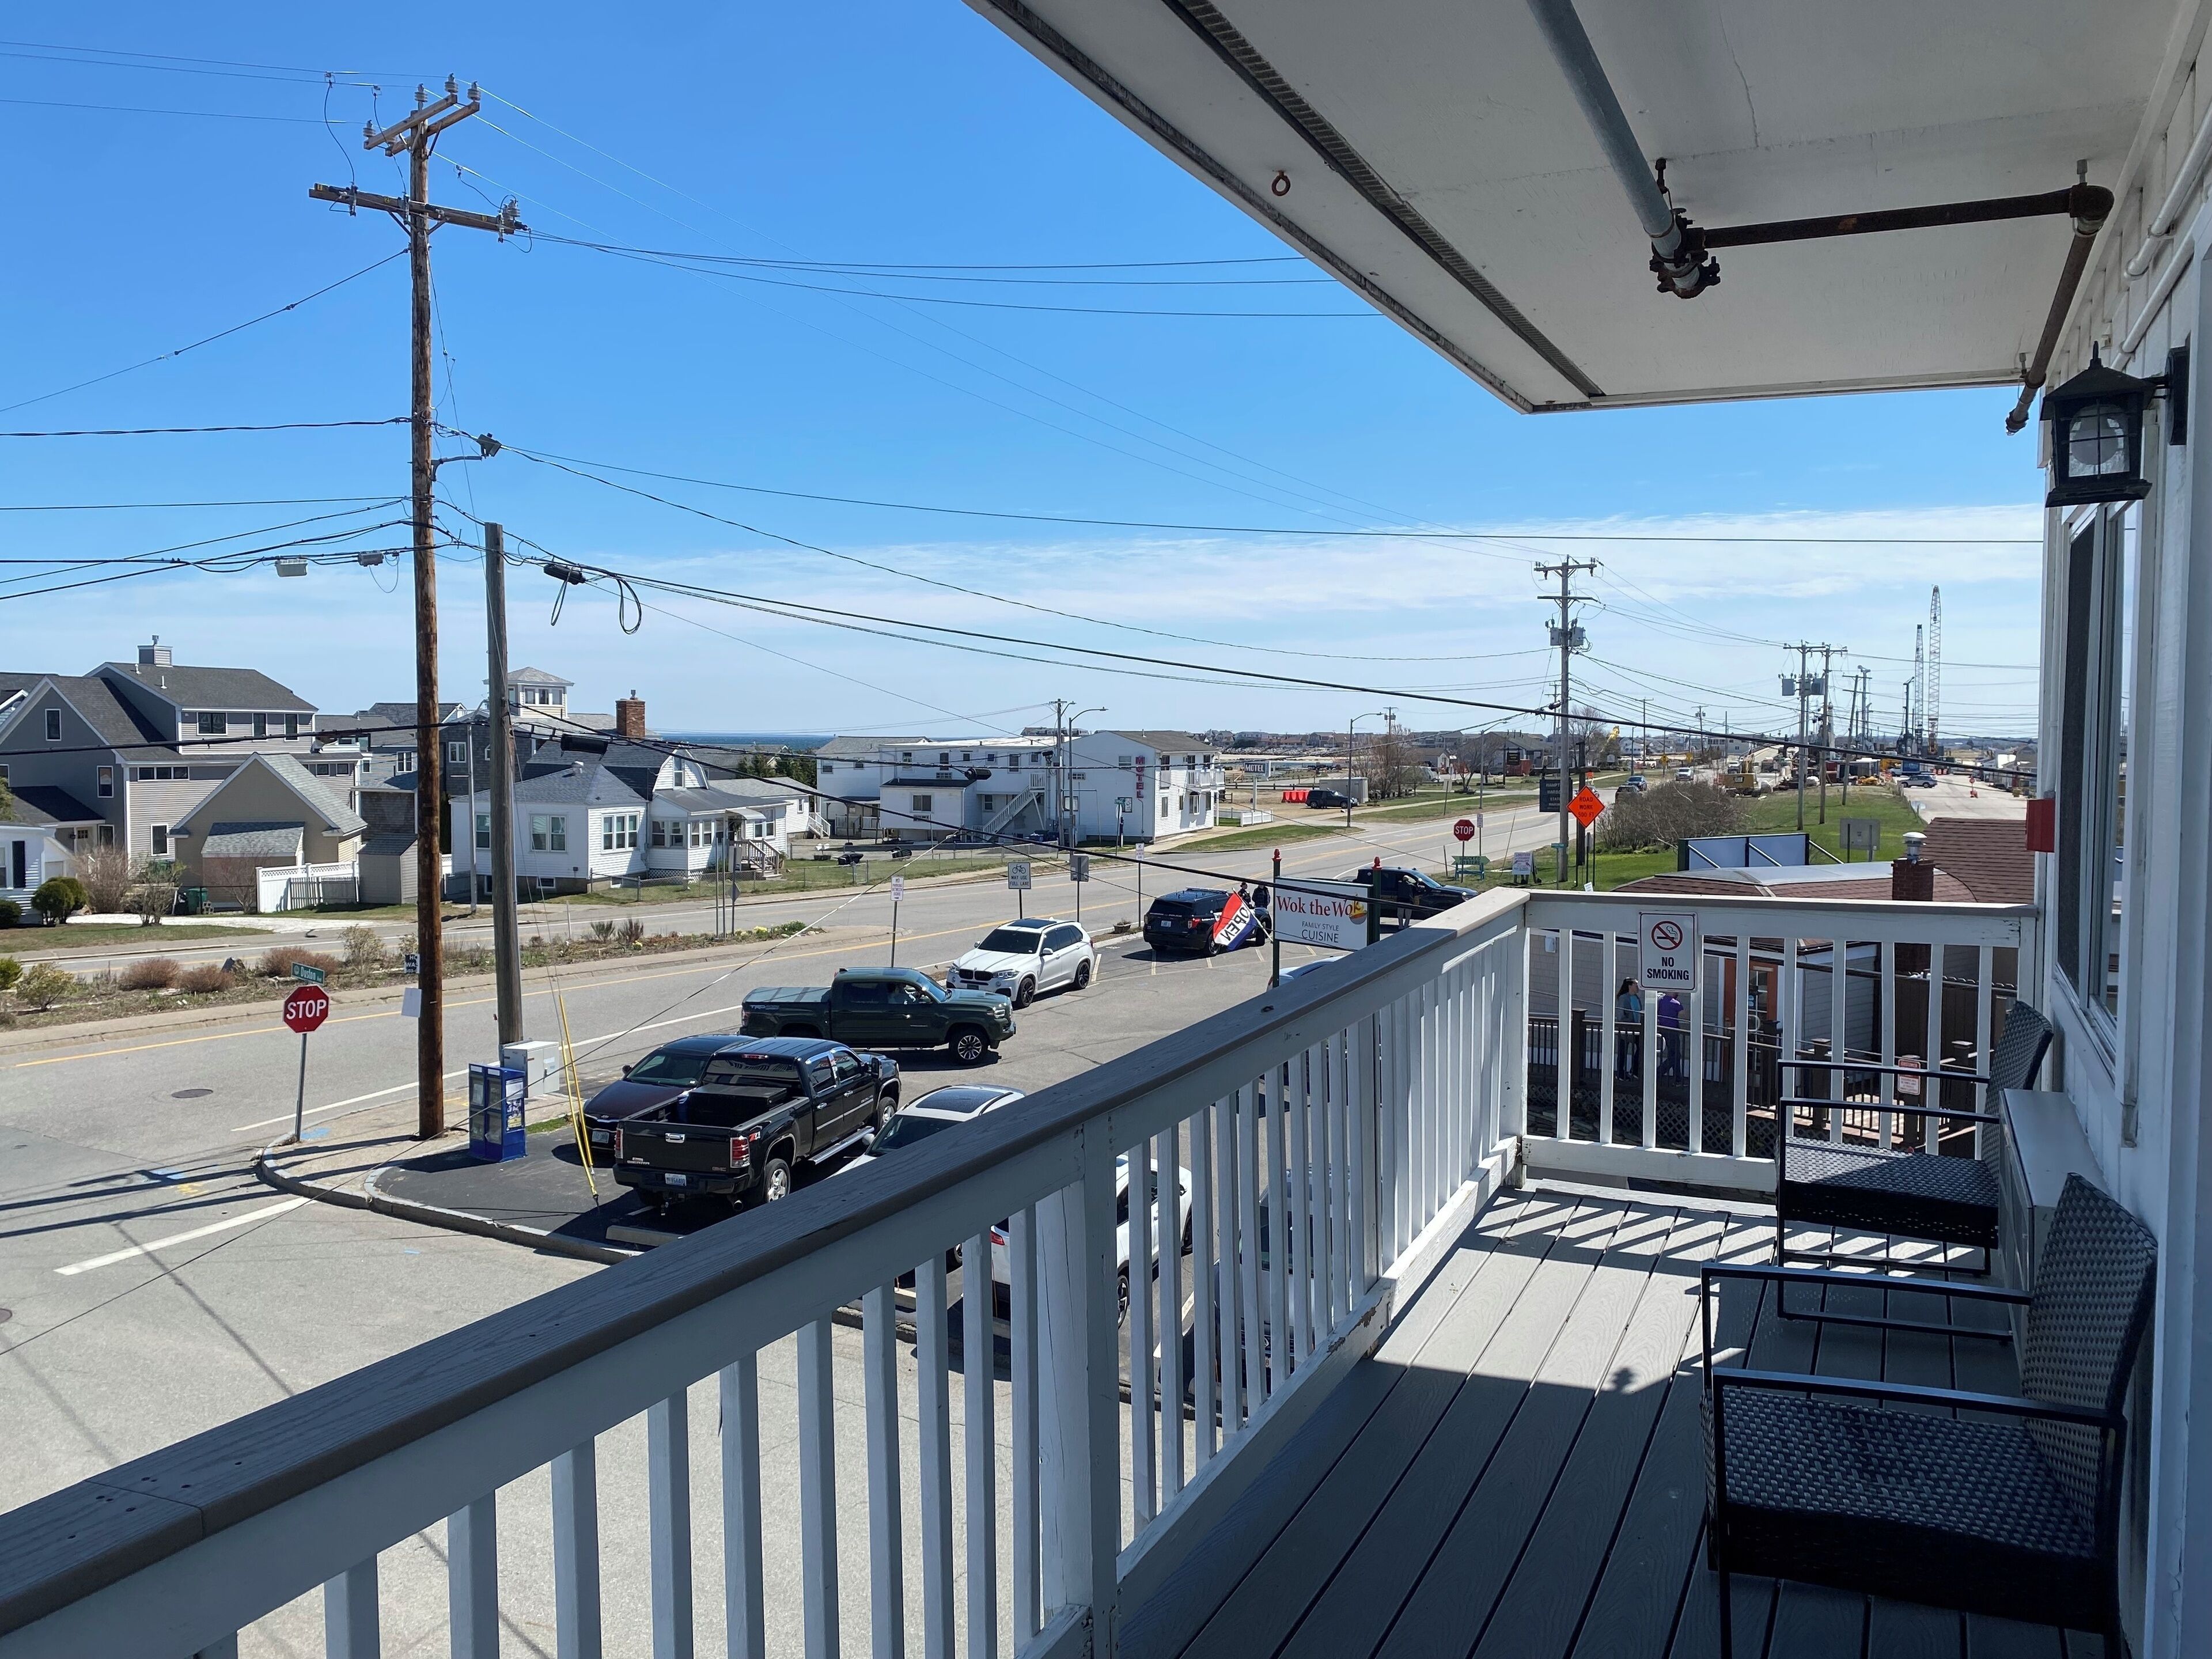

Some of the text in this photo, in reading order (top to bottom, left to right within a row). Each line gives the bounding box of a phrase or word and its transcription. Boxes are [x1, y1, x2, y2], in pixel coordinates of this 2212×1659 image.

[1245, 764, 1264, 772] MOTEL
[1135, 756, 1145, 798] MOTEL
[1455, 825, 1474, 835] STOP
[1276, 896, 1361, 918] Wok the Wok
[1302, 921, 1321, 929] FAMILY
[1301, 929, 1339, 944] CUISINE
[1661, 957, 1675, 967] NO
[1647, 968, 1690, 980] SMOKING
[286, 999, 327, 1020] STOP
